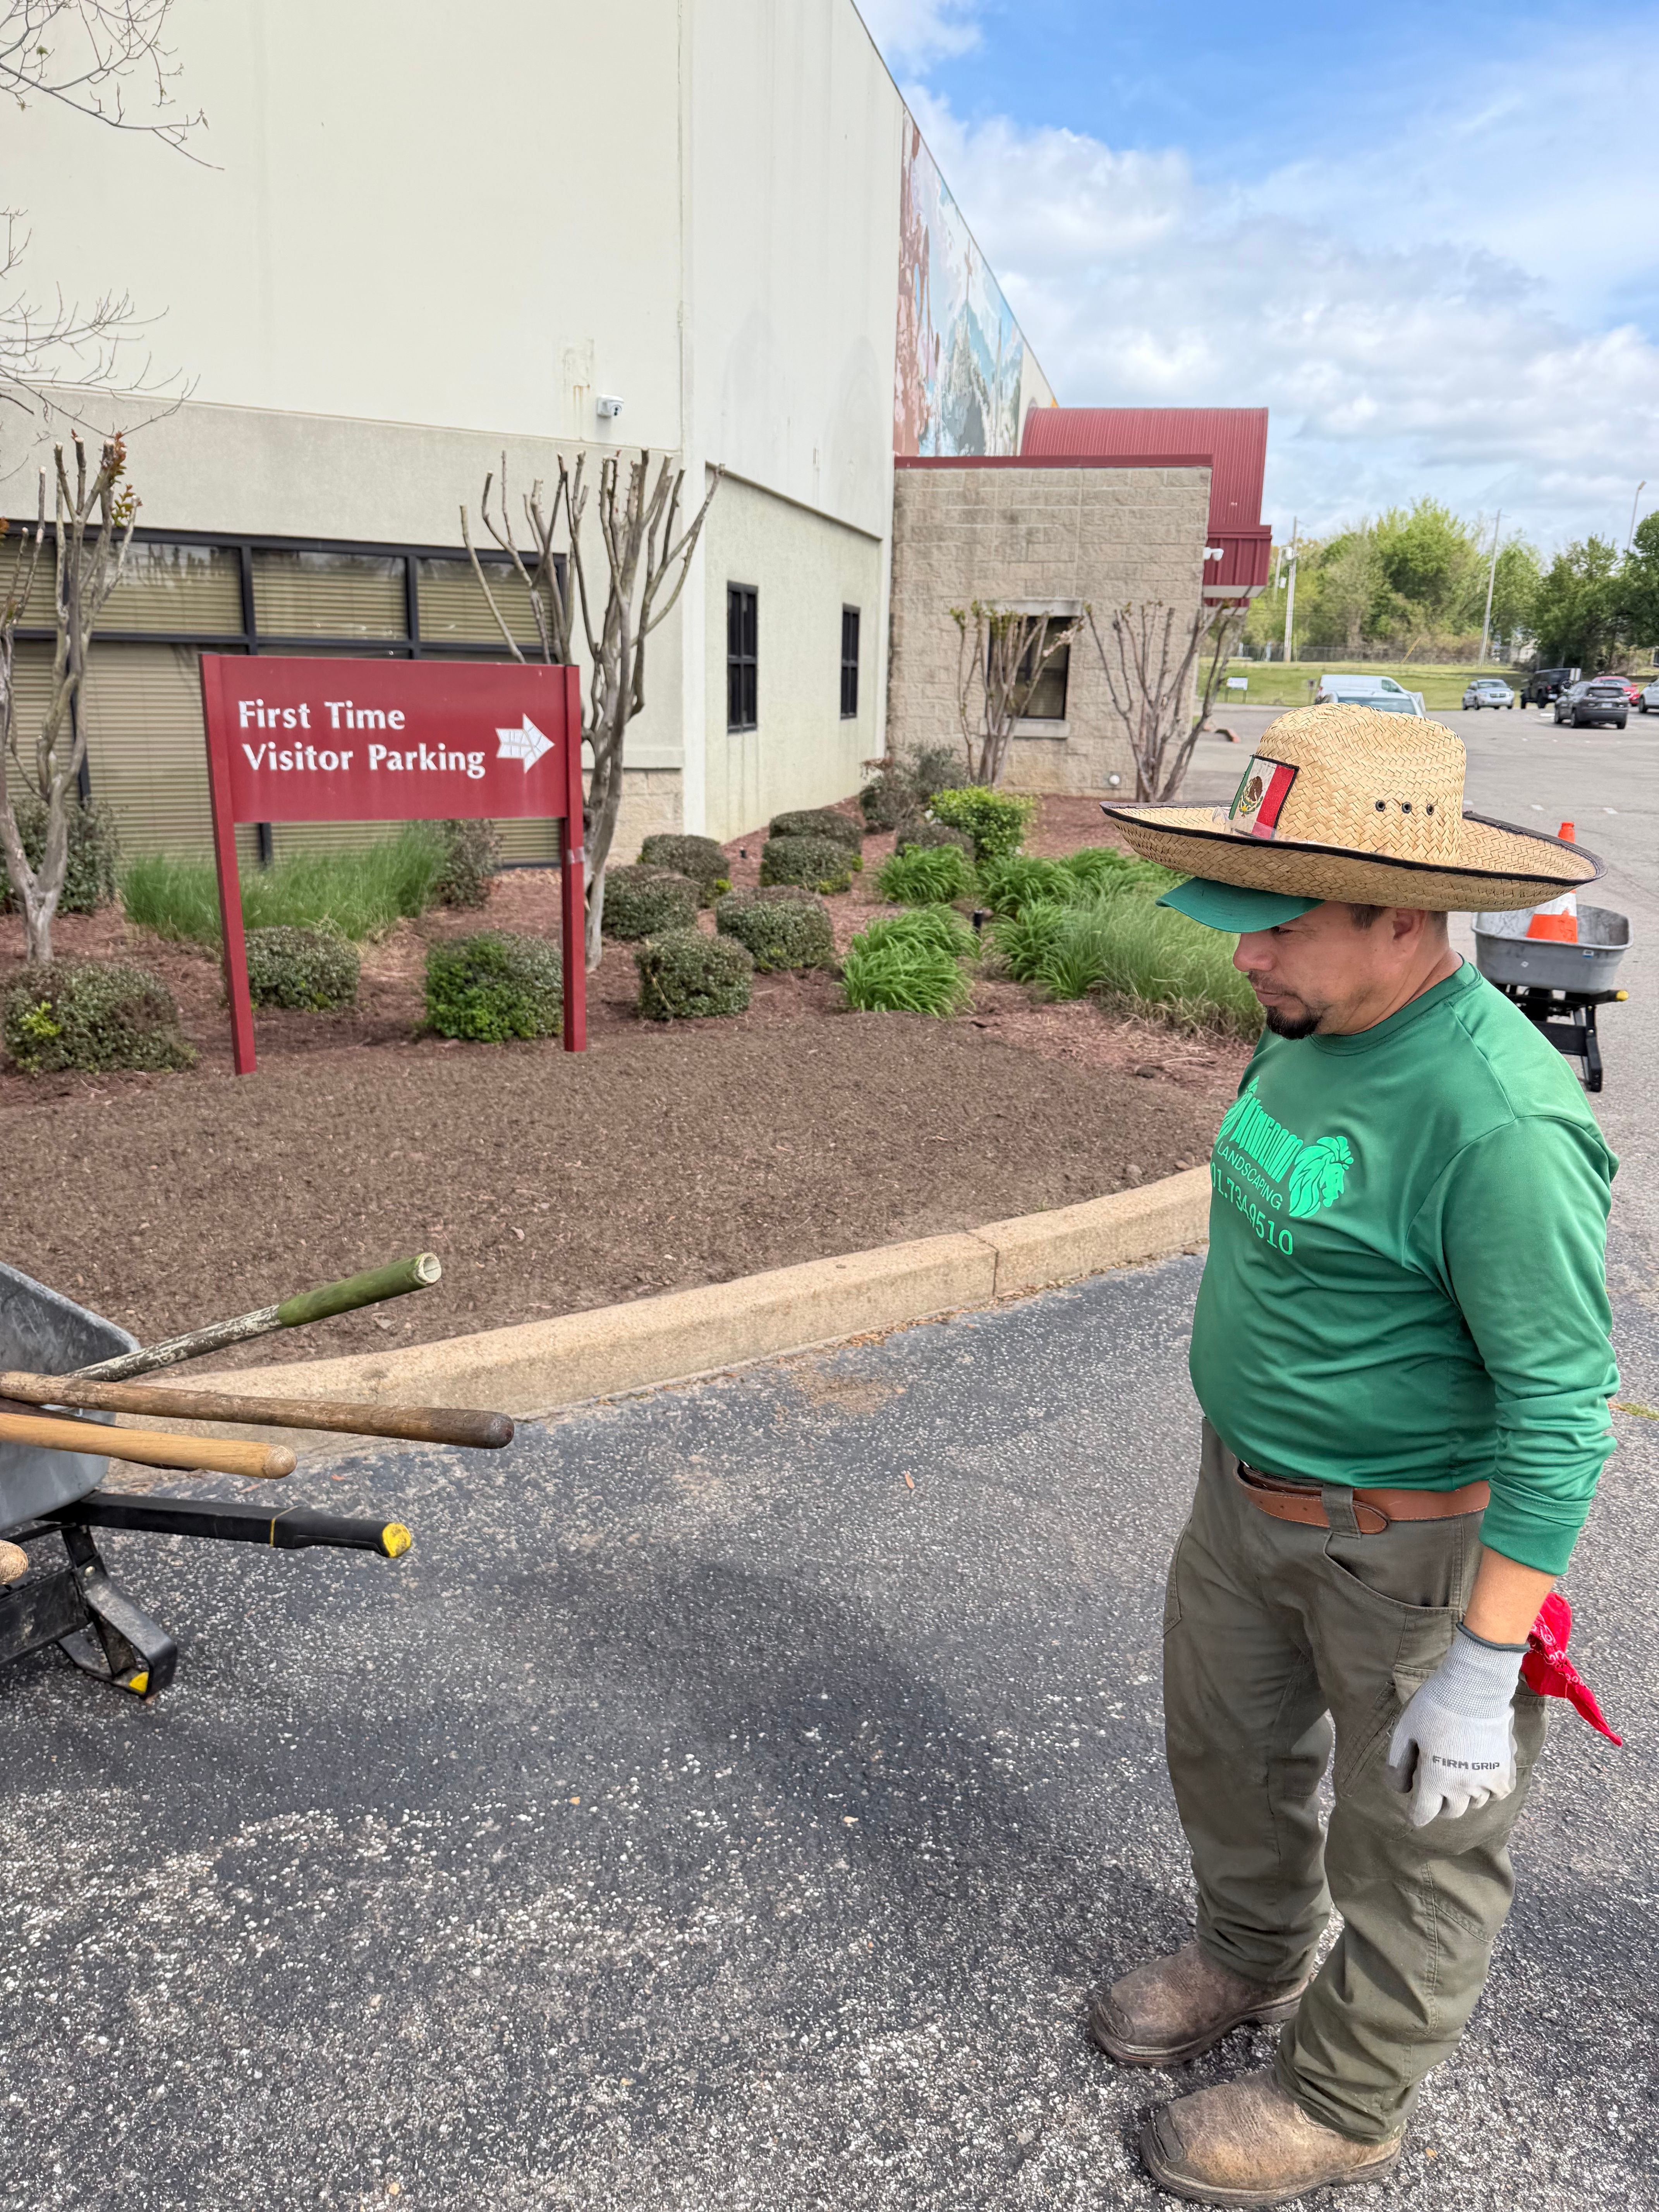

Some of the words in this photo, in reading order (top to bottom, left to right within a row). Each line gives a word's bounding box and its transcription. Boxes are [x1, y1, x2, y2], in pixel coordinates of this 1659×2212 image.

[238, 699, 311, 730] First
[324, 700, 405, 730] Time
[242, 742, 354, 771] Visitor
[368, 743, 486, 779] Parking
[1217, 1140, 1283, 1210] LANDSCAPING
[1432, 1755, 1469, 1770] FIRM
[1472, 1762, 1500, 1770] GRIP
